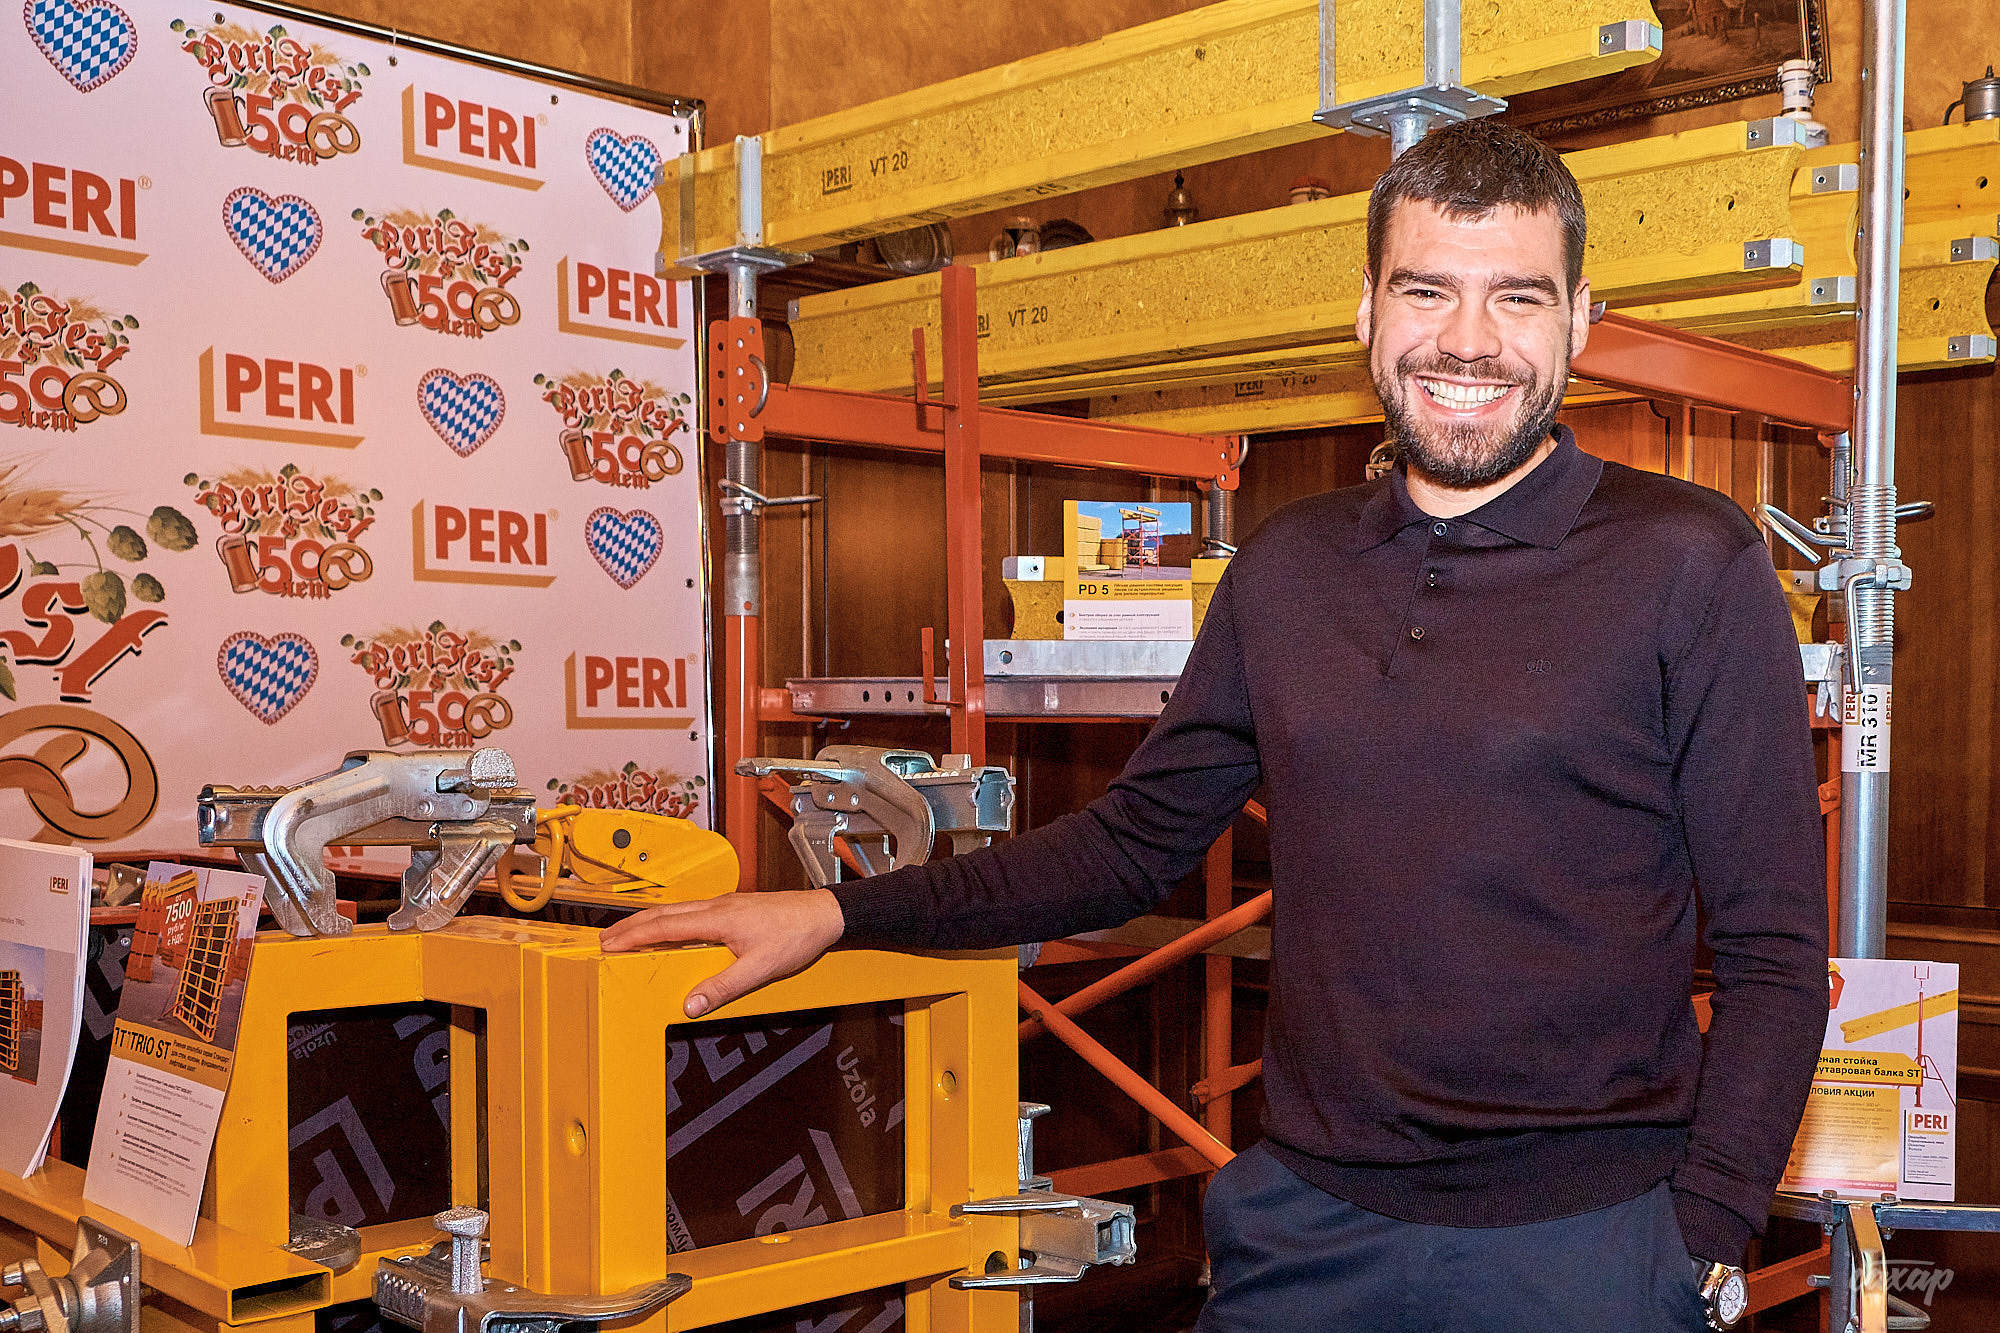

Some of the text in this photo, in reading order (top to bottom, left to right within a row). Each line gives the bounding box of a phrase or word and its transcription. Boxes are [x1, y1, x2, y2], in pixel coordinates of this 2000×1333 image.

[425, 93, 535, 169] PERI
[826, 151, 908, 188] PERI VT 20
[0, 156, 137, 241] PERI
[578, 262, 678, 329] PERI
[1008, 308, 1027, 328] VT
[1031, 305, 1048, 325] 20
[225, 353, 354, 425] PERI
[435, 505, 547, 566] PERI
[1079, 584, 1097, 595] PD
[1101, 584, 1109, 595] 5
[585, 656, 687, 708] PERI
[52, 876, 69, 890] PERI
[165, 898, 193, 924] 7500
[156, 1040, 172, 1060] ST
[1817, 1056, 1878, 1066] еная стойка
[1873, 1066, 1904, 1077] балка
[1906, 1068, 1920, 1078] ST
[836, 1045, 876, 1128] Uzola
[1811, 1087, 1875, 1098] ЛОВИЯ АКЦИИ
[1914, 1113, 1948, 1130] PERI
